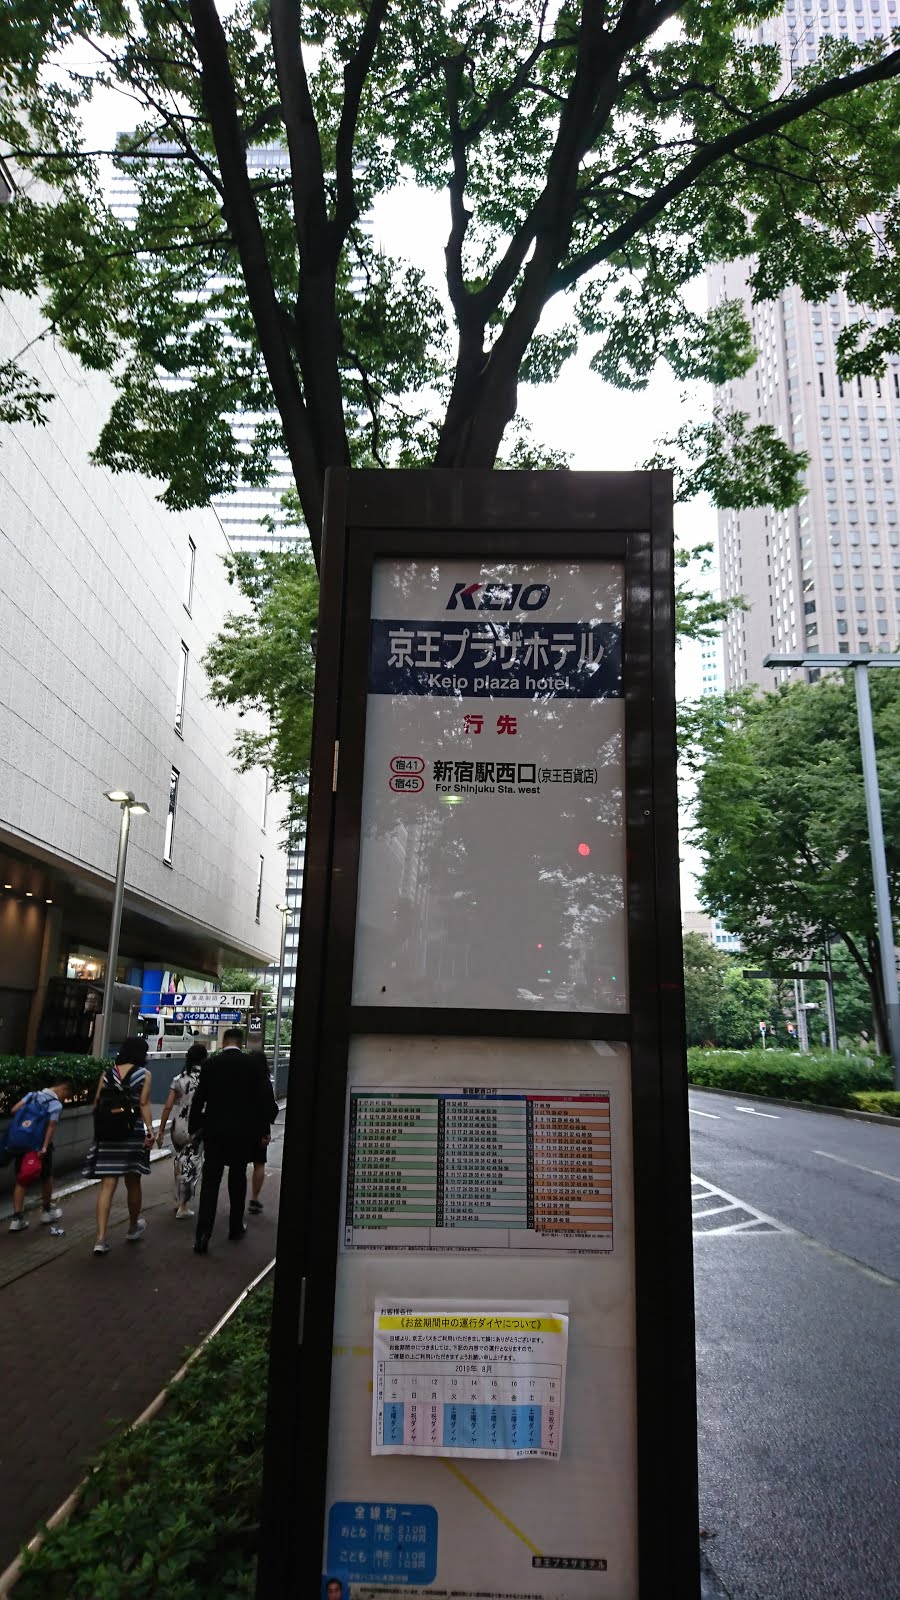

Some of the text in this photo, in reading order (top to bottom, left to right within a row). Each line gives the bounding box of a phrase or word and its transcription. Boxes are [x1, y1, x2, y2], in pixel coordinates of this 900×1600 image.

[446, 583, 550, 610] KEIO
[387, 628, 604, 672] 京王プラザホテル
[430, 674, 569, 692] Keio plaza hotel
[396, 760, 418, 770] 宿41
[433, 760, 536, 784] 新宿駅西口
[395, 779, 419, 789] 宿45
[436, 784, 540, 795] For Shinjuku Sta. west
[174, 994, 182, 1005] P
[220, 995, 245, 1006] 2.1m
